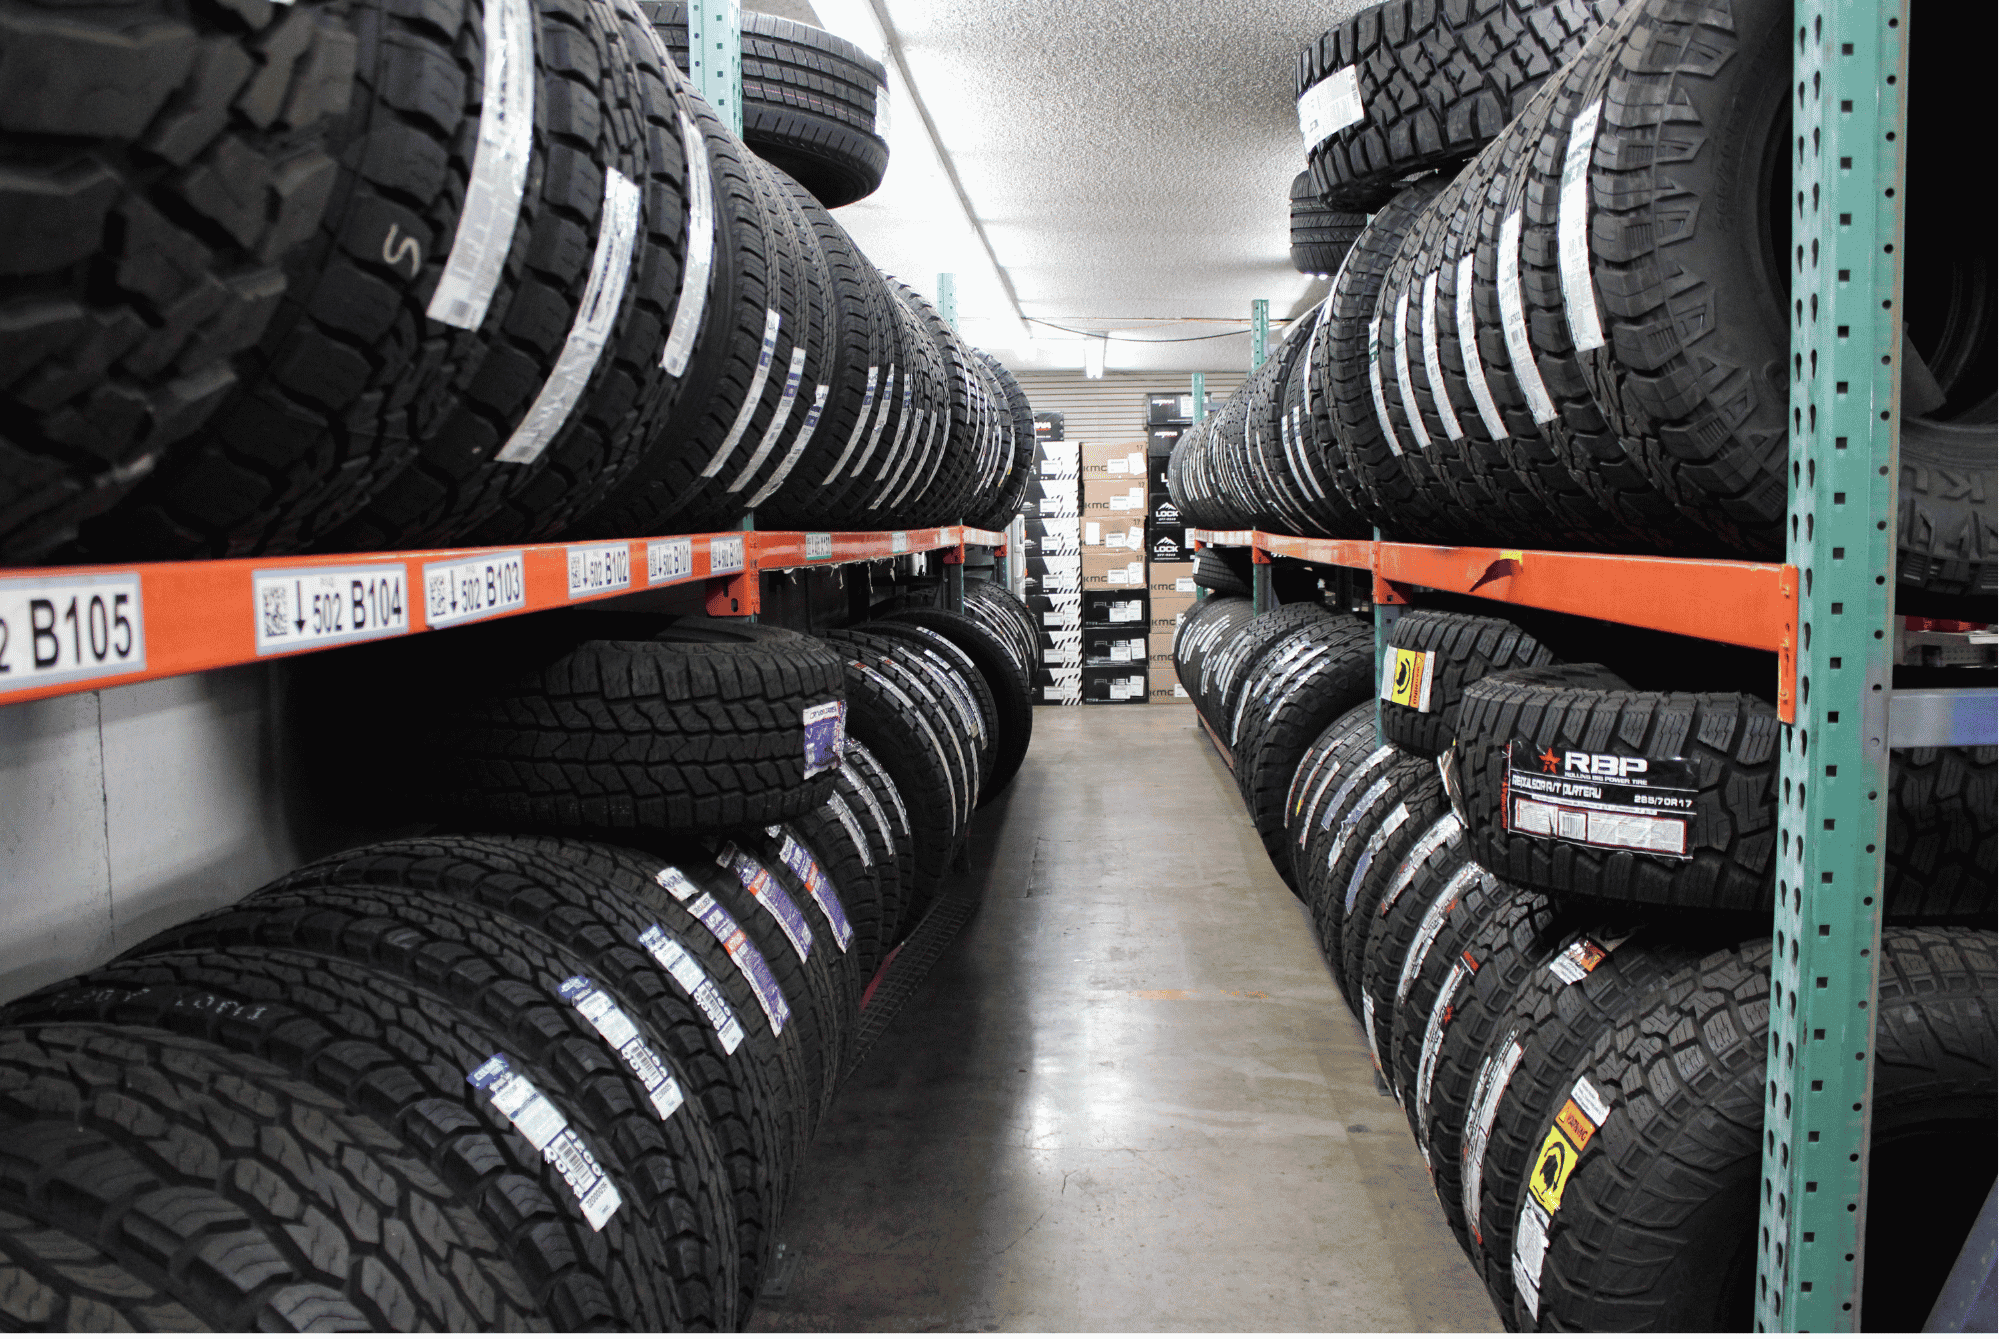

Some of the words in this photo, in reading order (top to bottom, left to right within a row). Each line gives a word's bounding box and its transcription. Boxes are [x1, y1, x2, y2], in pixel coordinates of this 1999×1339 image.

[1155, 510, 1179, 518] LOCK
[1153, 545, 1179, 553] LOCK
[590, 560, 603, 588] 502
[605, 550, 628, 585] B102
[461, 577, 482, 613] 502
[486, 561, 520, 607] B103
[313, 592, 343, 634] 502
[352, 577, 402, 630] B104
[29, 593, 133, 670] B105
[1564, 750, 1649, 777] RBP
[1605, 775, 1631, 785] POWER
[1631, 778, 1648, 786] TIRE
